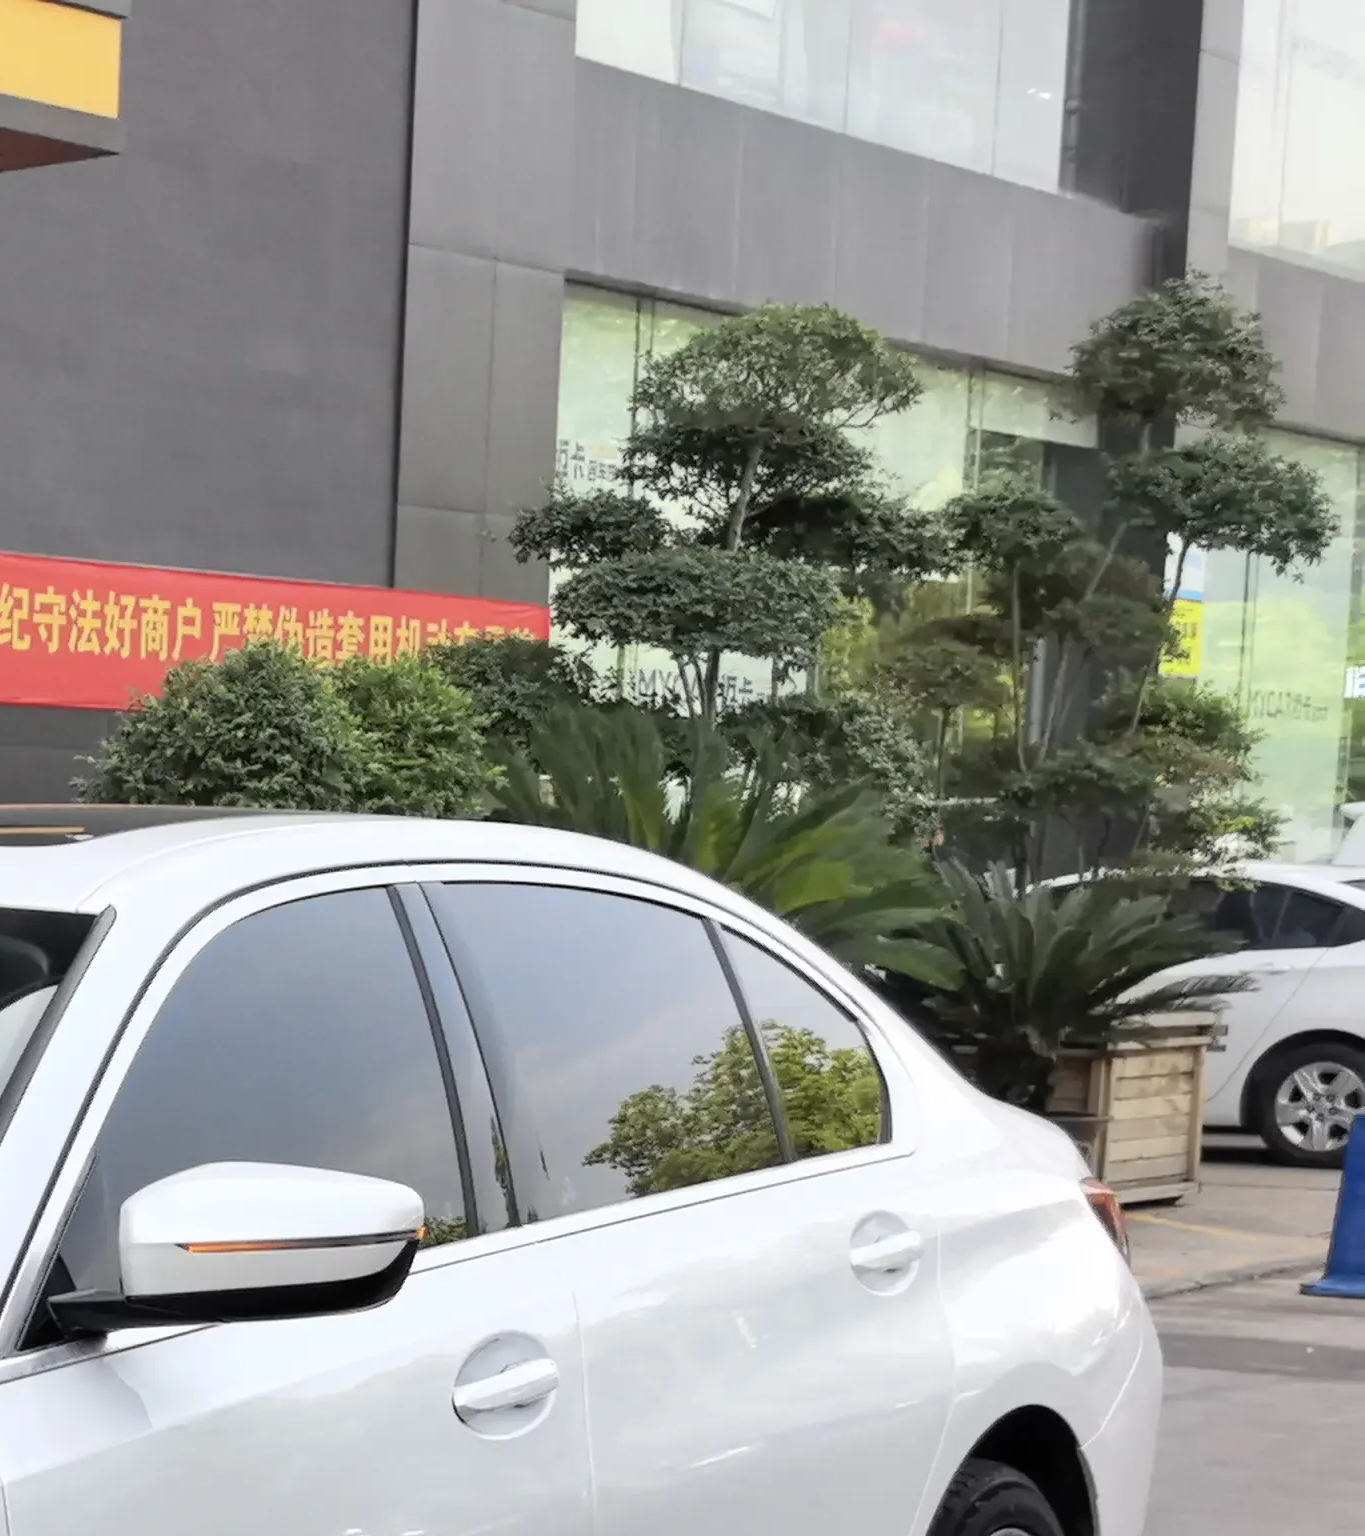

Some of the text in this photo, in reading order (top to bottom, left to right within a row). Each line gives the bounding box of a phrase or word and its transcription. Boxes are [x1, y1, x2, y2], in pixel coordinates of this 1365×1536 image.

[210, 602, 536, 668] 严禁伪造套用机动
